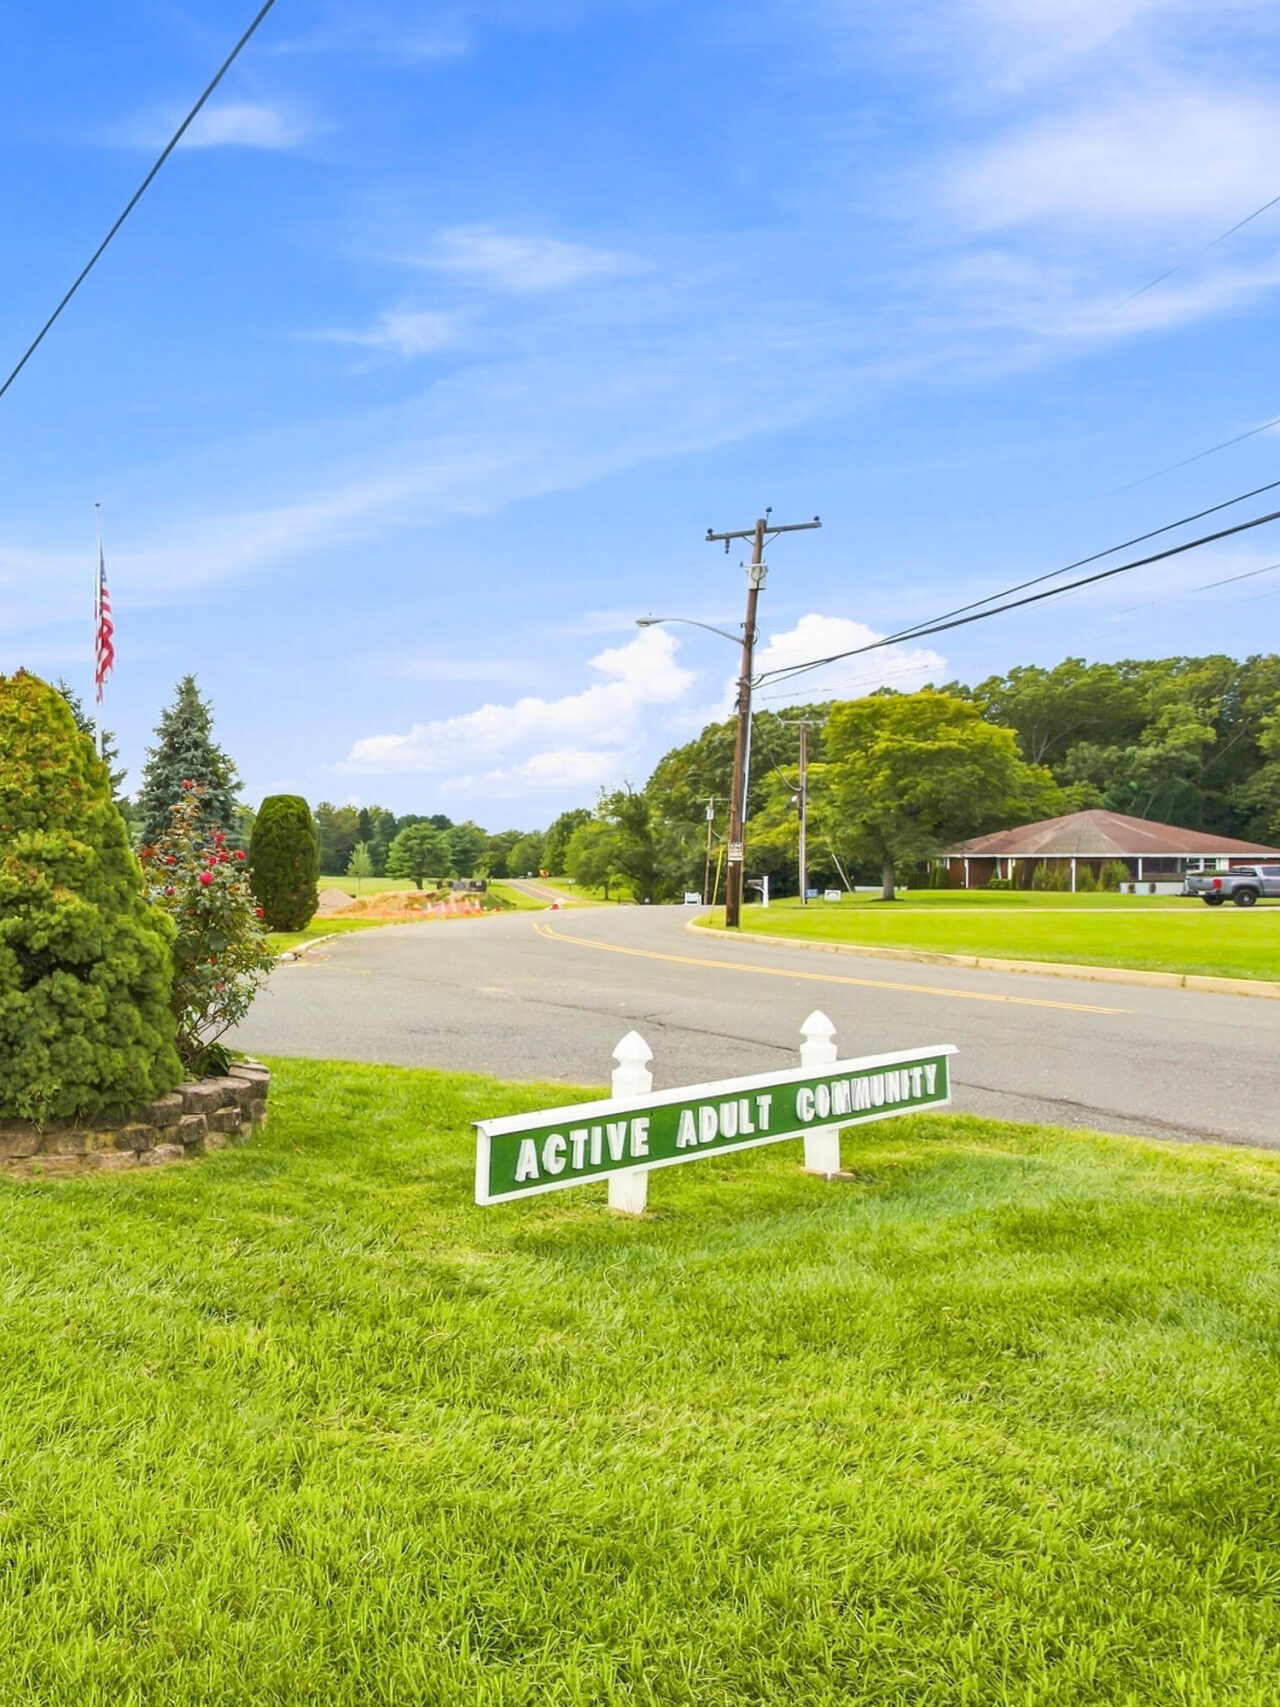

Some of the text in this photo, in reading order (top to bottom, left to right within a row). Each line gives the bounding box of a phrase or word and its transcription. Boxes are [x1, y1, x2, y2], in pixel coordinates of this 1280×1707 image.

[514, 1064, 937, 1182] ACTIVE ADULT COMMUNITY
